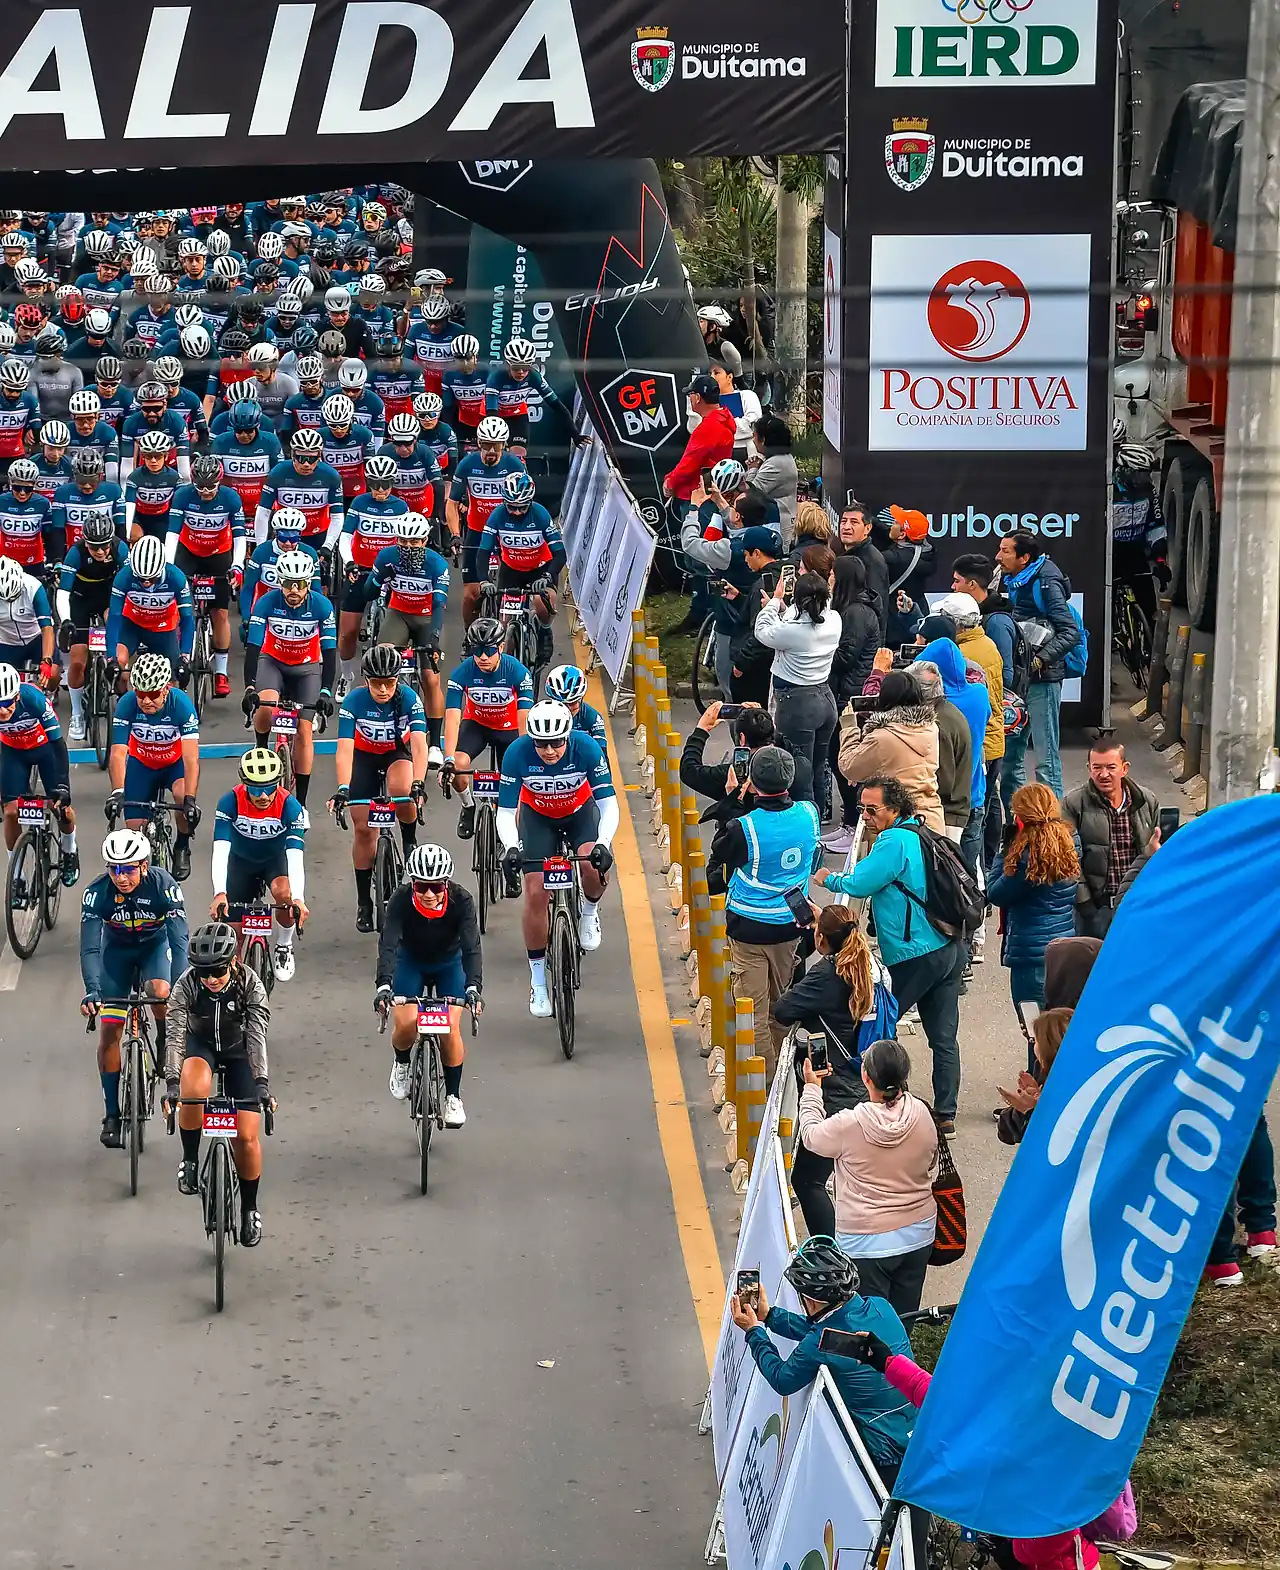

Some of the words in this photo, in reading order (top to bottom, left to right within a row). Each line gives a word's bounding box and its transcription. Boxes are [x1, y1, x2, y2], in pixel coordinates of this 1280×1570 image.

[682, 43, 741, 54] MUNICIPIO
[744, 43, 760, 53] DE
[892, 24, 1080, 77] IERD
[681, 55, 807, 80] Duitama
[943, 139, 1012, 150] MUNICIPIO
[1015, 139, 1032, 150] DE
[942, 150, 1084, 178] Duitama
[619, 379, 656, 408] GF
[880, 369, 1079, 412] POSITIVA
[623, 409, 668, 436] BM
[976, 416, 993, 426] DE
[995, 413, 1061, 427] SEGUROS
[325, 453, 360, 463] GFBM
[229, 461, 265, 473] GFBM
[282, 492, 324, 505] GFBM
[3, 518, 41, 532] GFBM
[186, 516, 225, 528] GFBM
[927, 506, 1080, 538] urbaser
[502, 536, 541, 546] GFBM
[272, 624, 316, 637] GFBM
[472, 692, 511, 706] GFBM
[276, 718, 293, 727] 652
[131, 727, 179, 742] GFBM
[477, 782, 494, 790] 771
[529, 780, 582, 793] GFBM
[18, 809, 43, 818] 1006
[372, 812, 391, 822] 769
[548, 872, 568, 882] 676
[245, 918, 271, 928] 2545
[420, 1015, 448, 1025] 2543
[206, 1115, 236, 1128] 2542
[1051, 1005, 1265, 1441] Electrolit
